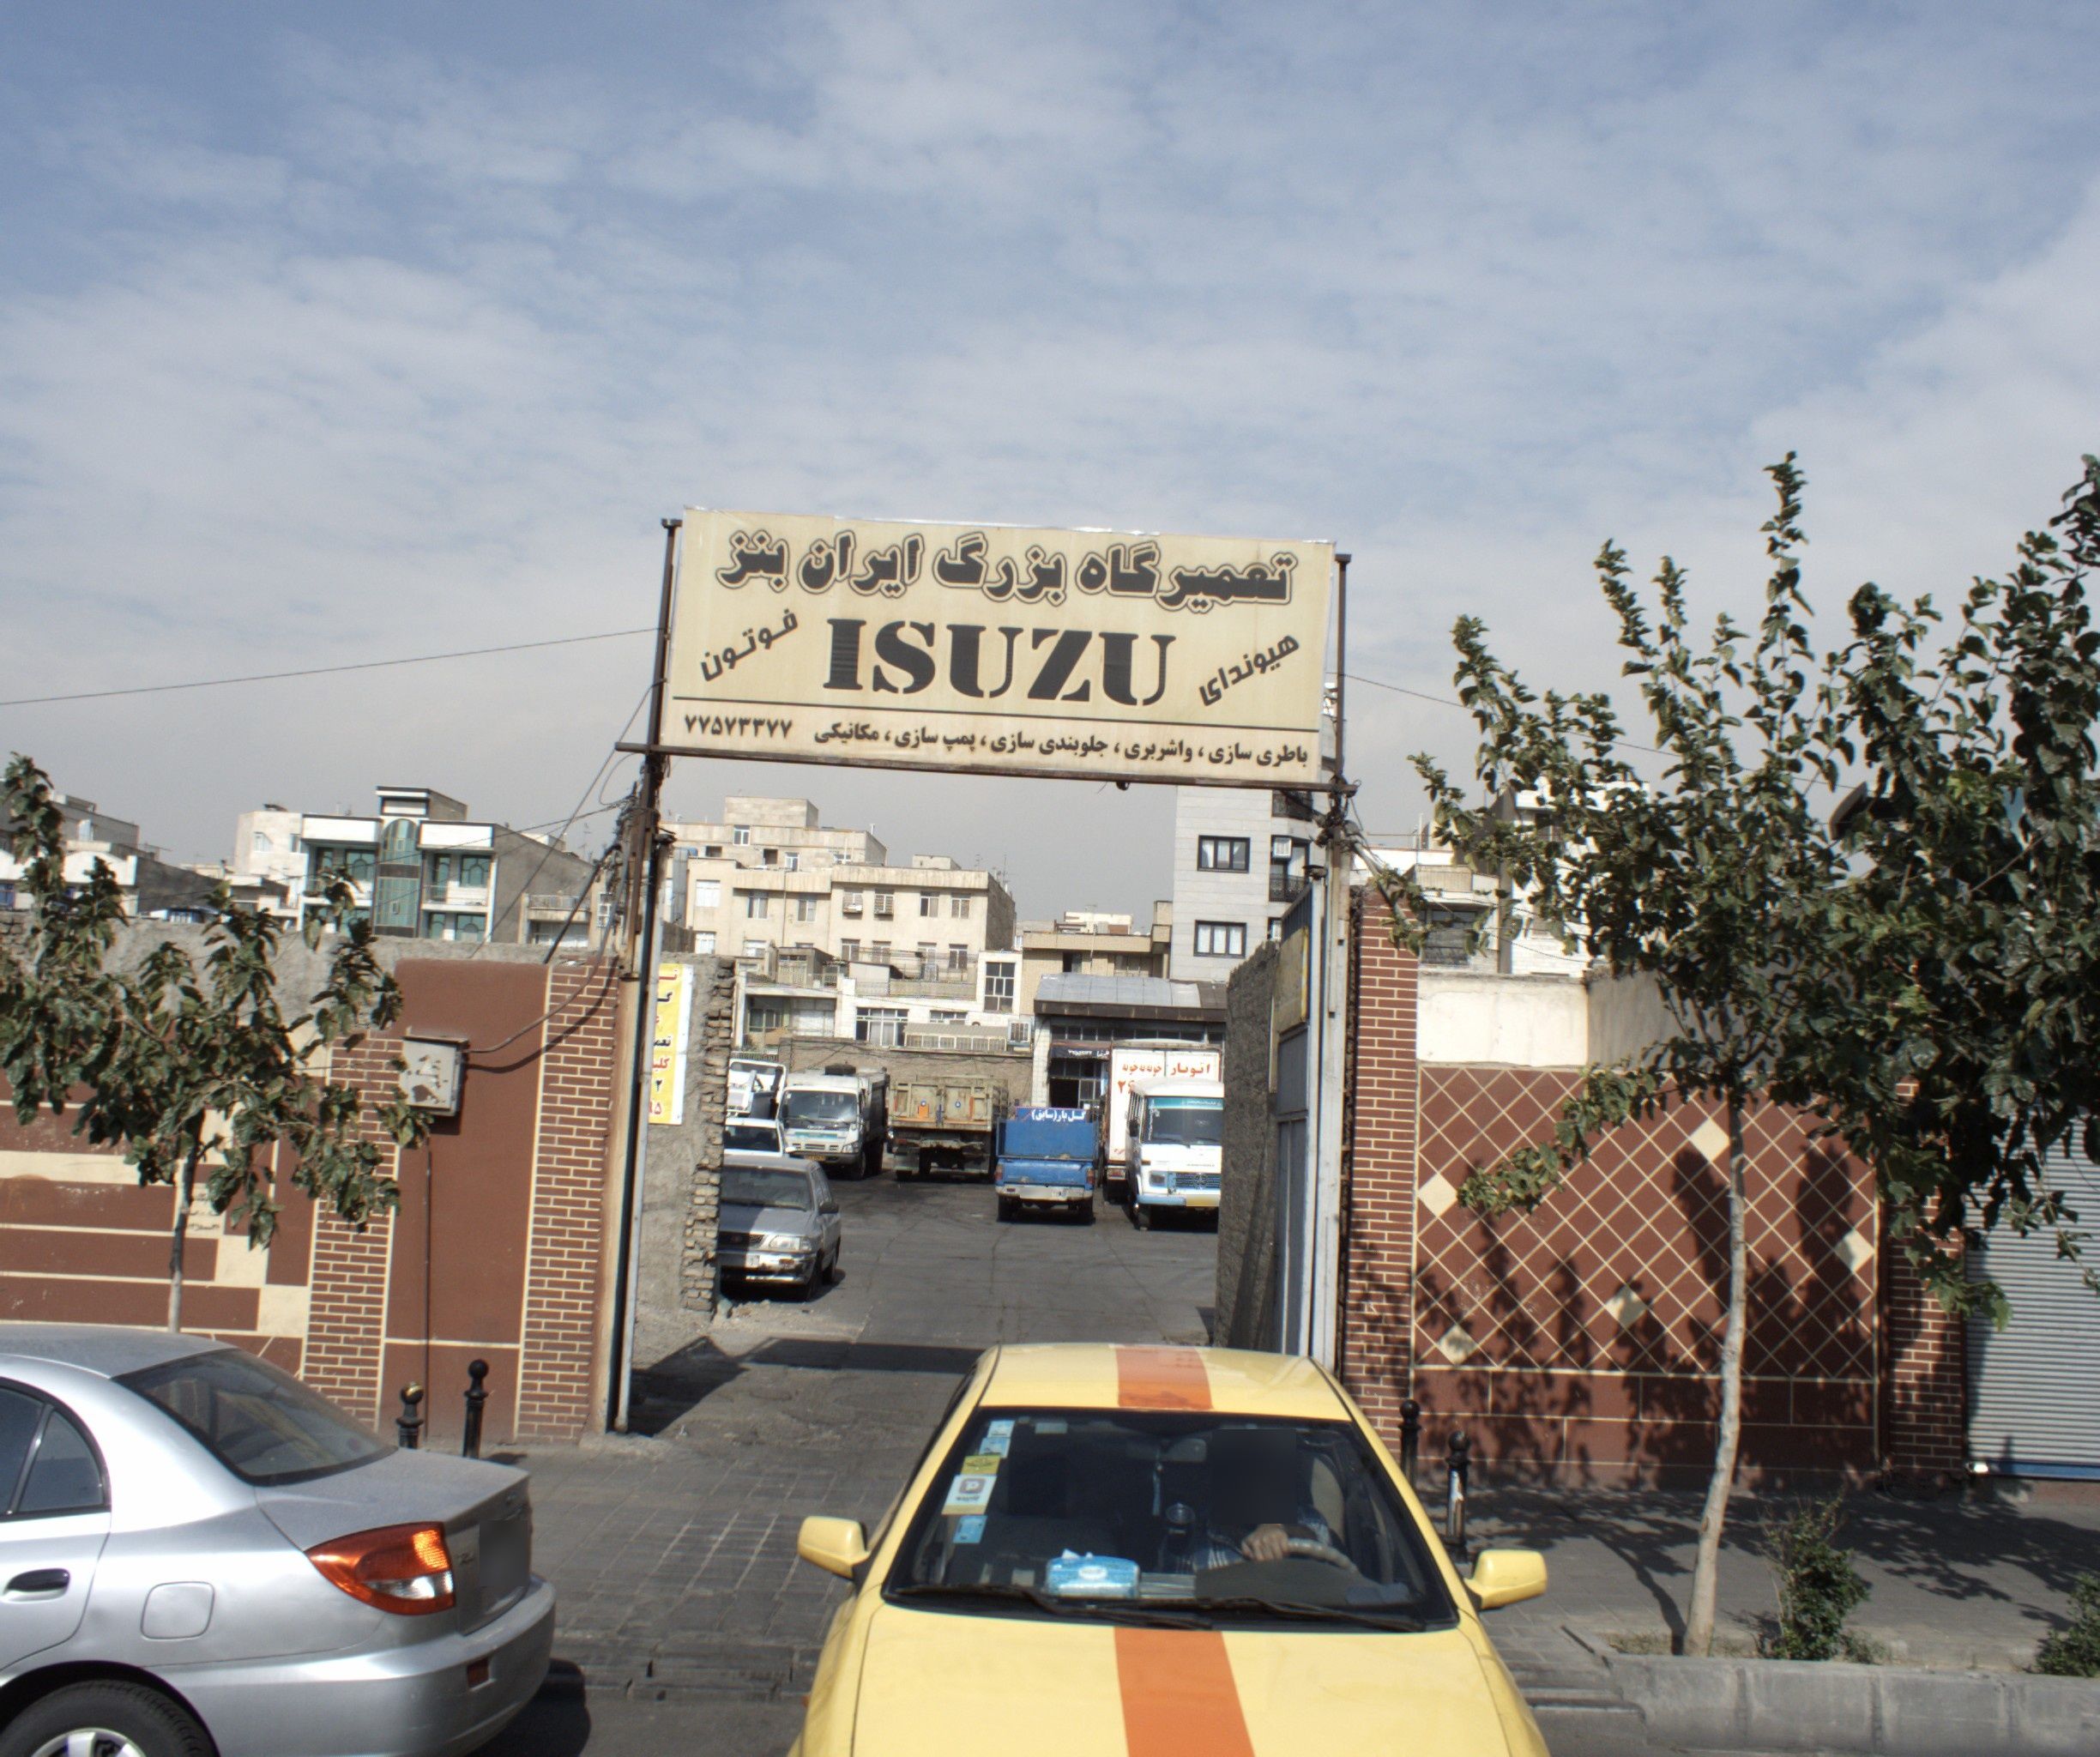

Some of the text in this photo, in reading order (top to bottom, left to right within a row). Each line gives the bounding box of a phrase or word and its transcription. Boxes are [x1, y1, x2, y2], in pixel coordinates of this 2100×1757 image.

[715, 528, 791, 595] بنز
[796, 529, 926, 600] ایران
[932, 531, 1067, 608] بزرگ
[700, 608, 799, 682] فوتون
[822, 617, 1177, 707] ISUZU
[1198, 634, 1300, 707] هیوندای
[685, 713, 793, 740] ۷۷۵۷۳۳۷۷
[813, 722, 879, 746] مکانیکی
[942, 728, 976, 753] پمپ
[1038, 733, 1109, 758] جلوبندی
[1256, 743, 1308, 768] باطری
